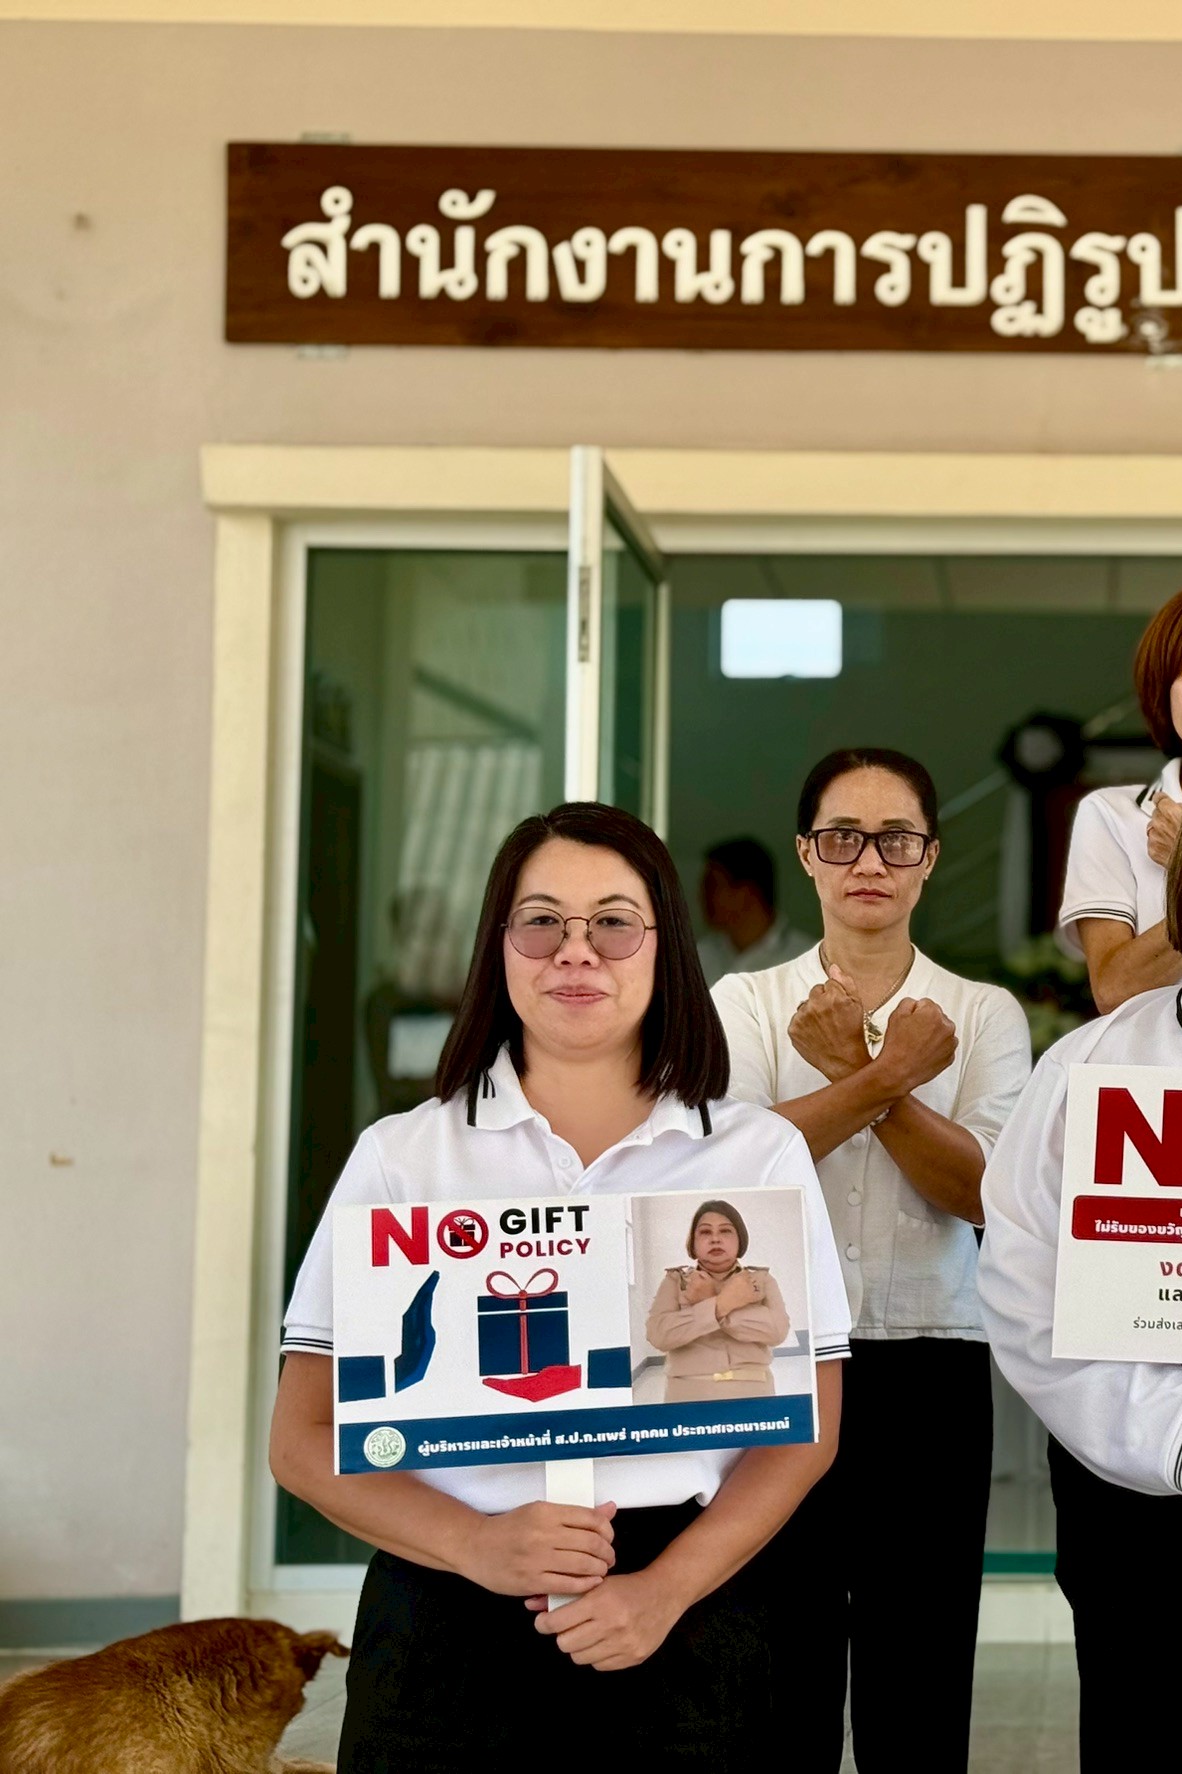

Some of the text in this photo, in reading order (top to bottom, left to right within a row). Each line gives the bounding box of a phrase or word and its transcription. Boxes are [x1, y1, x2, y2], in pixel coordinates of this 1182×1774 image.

[499, 1205, 590, 1235] GIFT
[499, 1238, 591, 1259] POLICY
[417, 1416, 790, 1457] ผู้บริหารและเจ้าหน้าที่ ส.ป.ก.แพร่ ทุกคน ประกาศเจตนารมณ์
